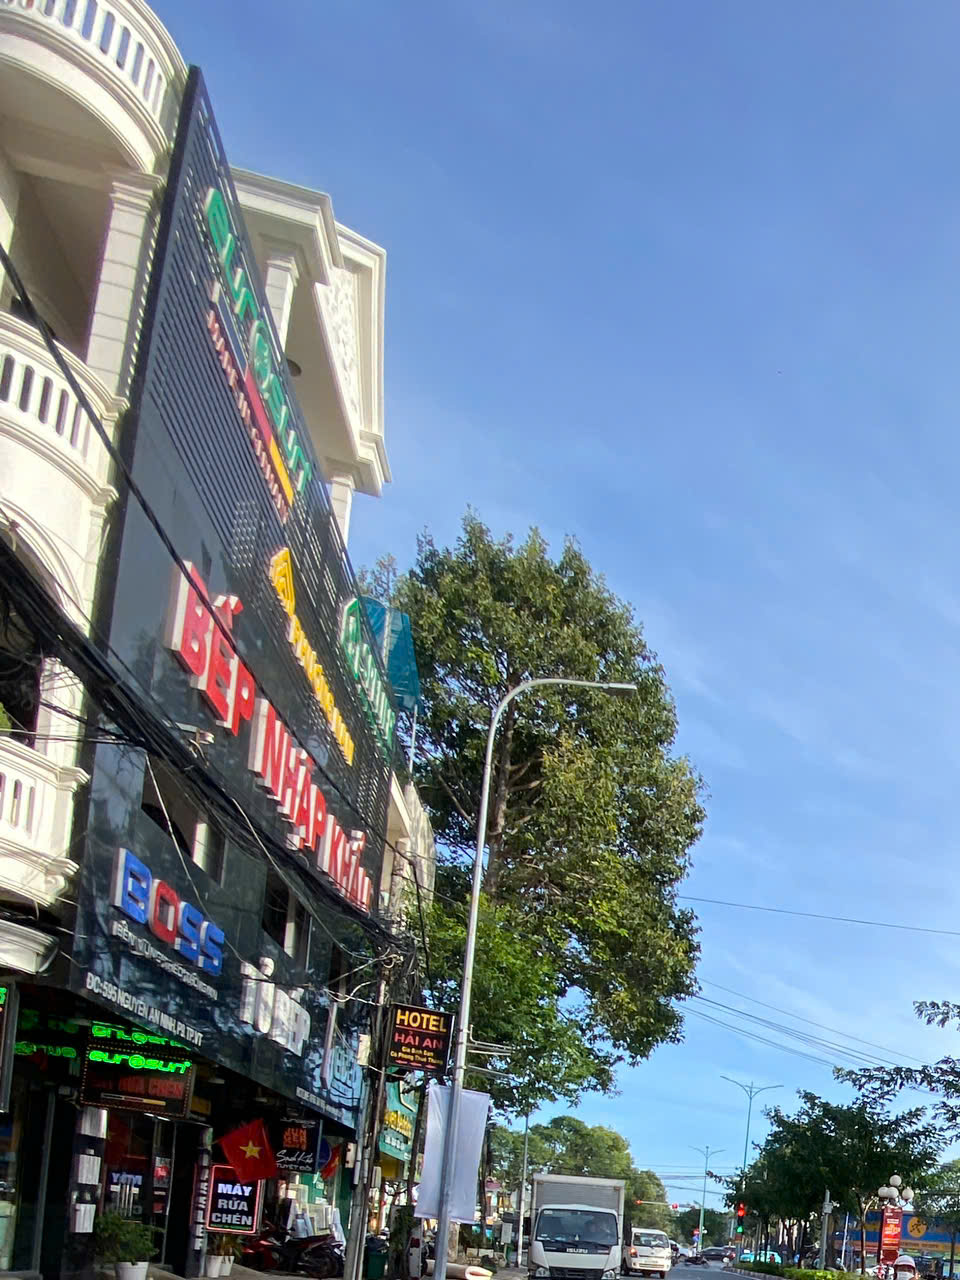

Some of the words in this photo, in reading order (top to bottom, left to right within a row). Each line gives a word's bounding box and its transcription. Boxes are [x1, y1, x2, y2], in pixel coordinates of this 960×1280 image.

[172, 560, 256, 737] BẾP
[252, 697, 327, 853] NHẬP
[395, 1008, 447, 1033] HOTEL
[394, 1031, 420, 1046] HẢI
[422, 1038, 444, 1049] AN
[217, 1183, 252, 1197] MÁY
[217, 1197, 248, 1212] RỬA
[211, 1212, 252, 1225] CHÉN
